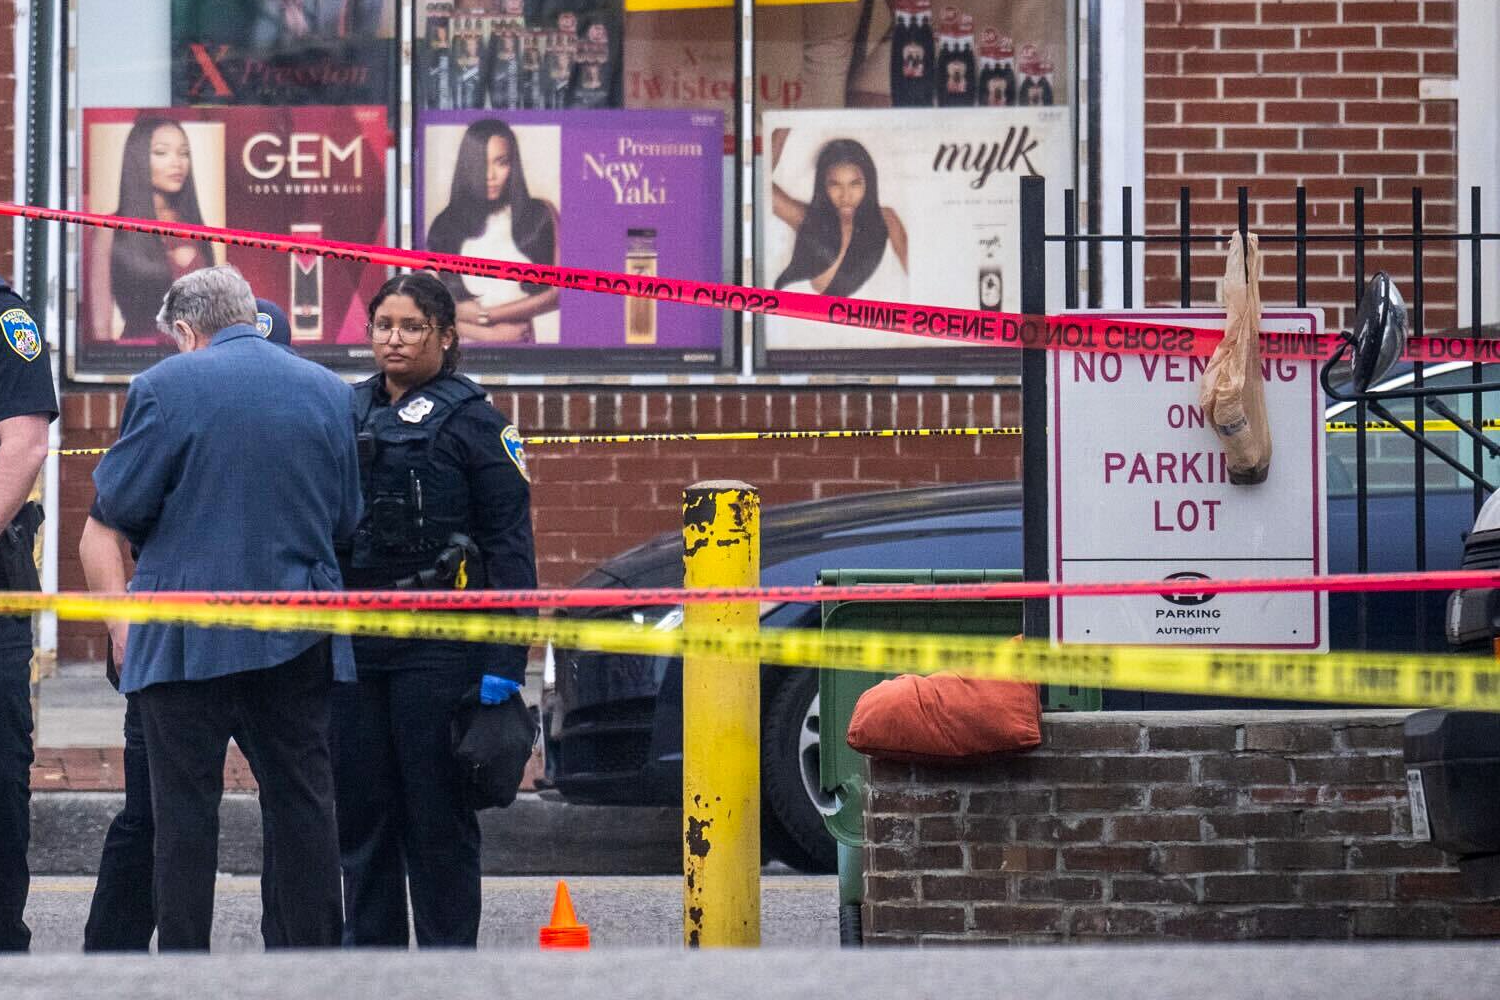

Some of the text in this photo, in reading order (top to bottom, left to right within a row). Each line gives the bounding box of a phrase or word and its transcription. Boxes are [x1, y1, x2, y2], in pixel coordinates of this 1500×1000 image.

[760, 75, 803, 105] Up
[242, 132, 364, 180] GEM
[618, 136, 703, 157] Premium
[932, 126, 1039, 190] mylk
[582, 152, 644, 181] New
[610, 177, 666, 205] Yaki
[1074, 354, 1122, 383] NO
[1167, 404, 1205, 429] ON
[1153, 500, 1222, 532] LOT
[1156, 609, 1221, 619] PARKING
[1156, 627, 1221, 636] AUTHORITY
